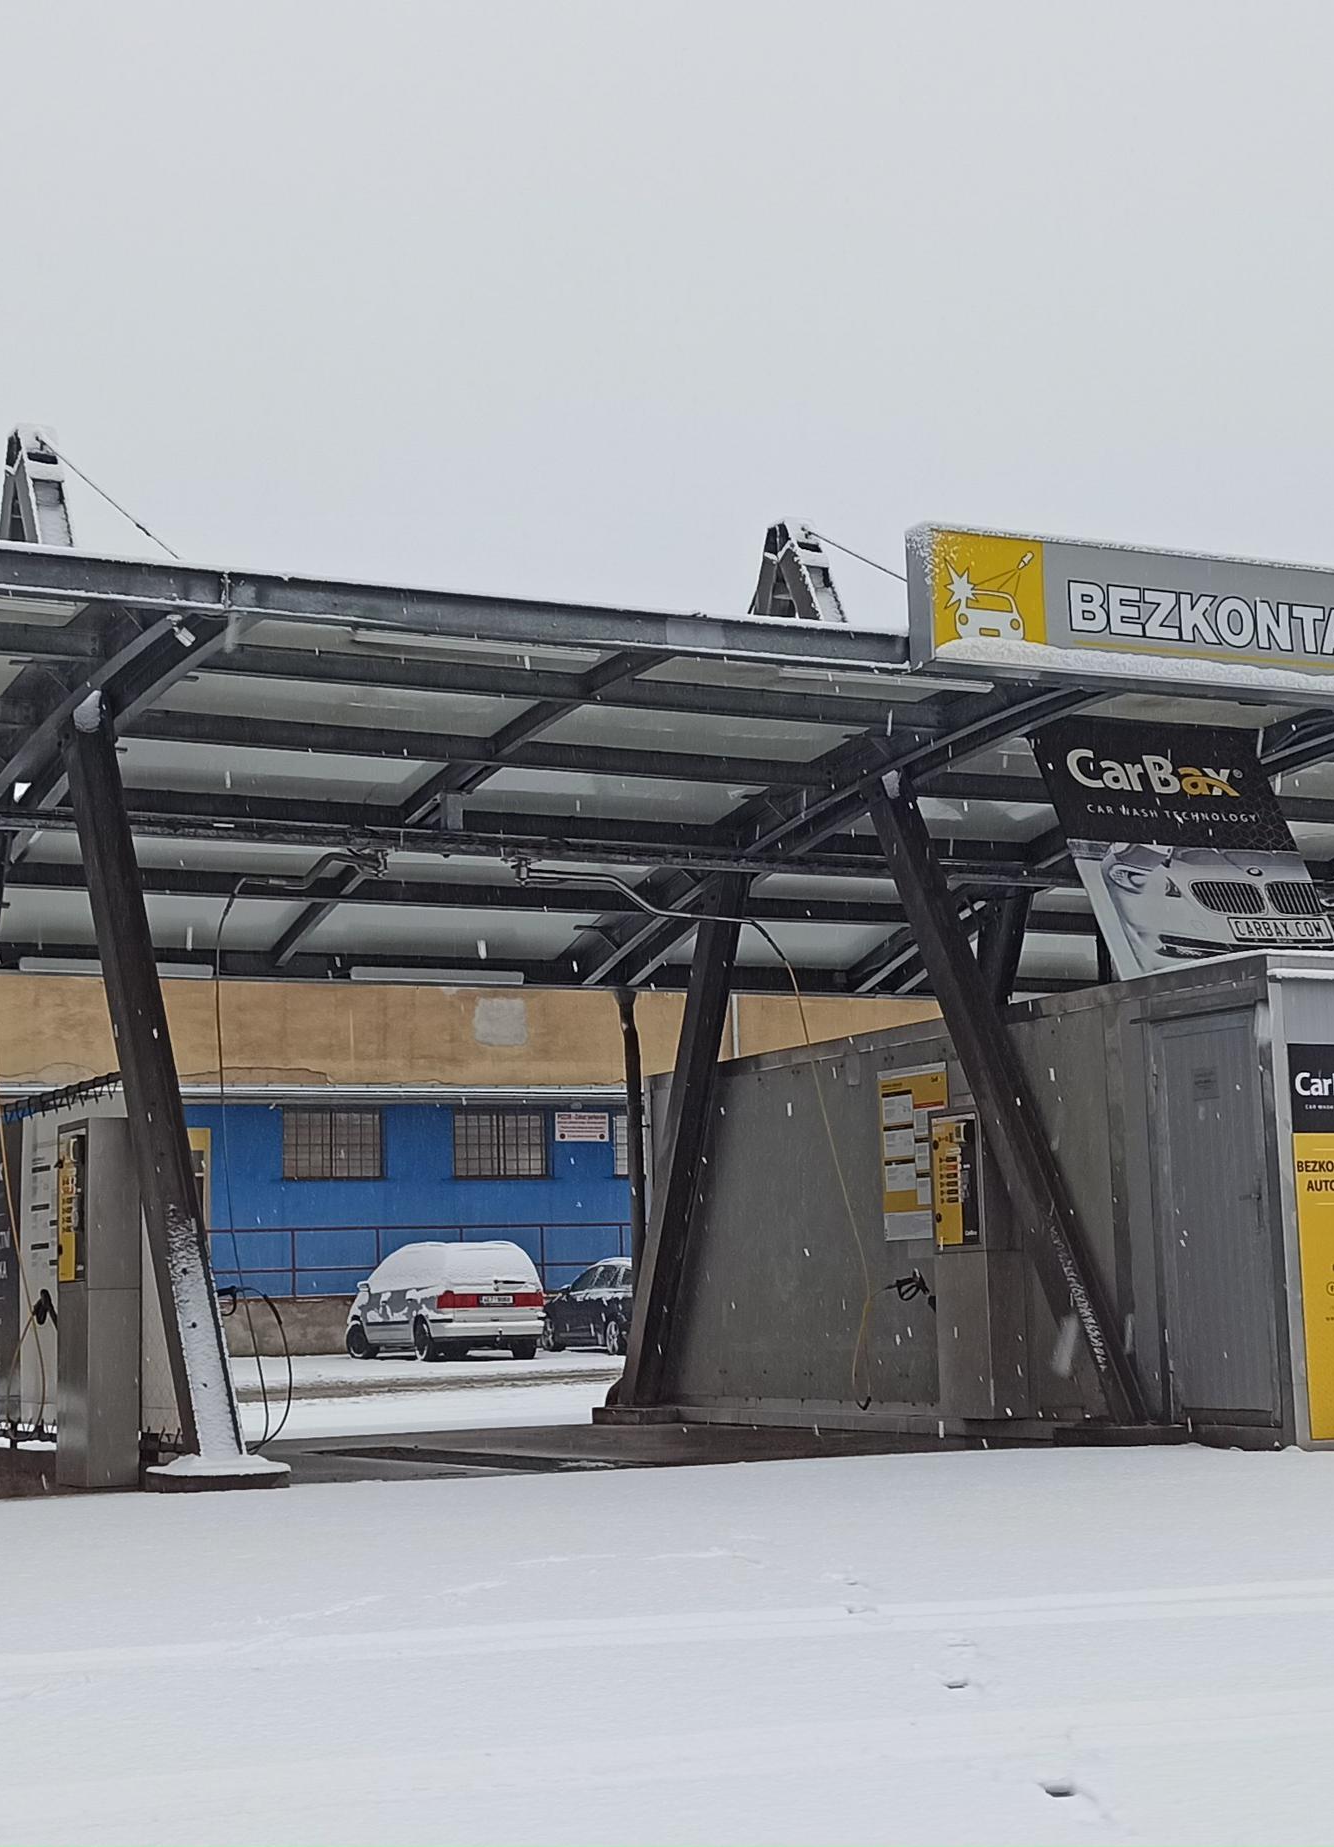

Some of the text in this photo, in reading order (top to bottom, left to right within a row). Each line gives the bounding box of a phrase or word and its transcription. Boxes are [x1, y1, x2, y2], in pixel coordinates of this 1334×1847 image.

[1086, 804, 1258, 823] CAR WASH TECHNOLOGY
[1233, 918, 1324, 938] CARBAX.COM
